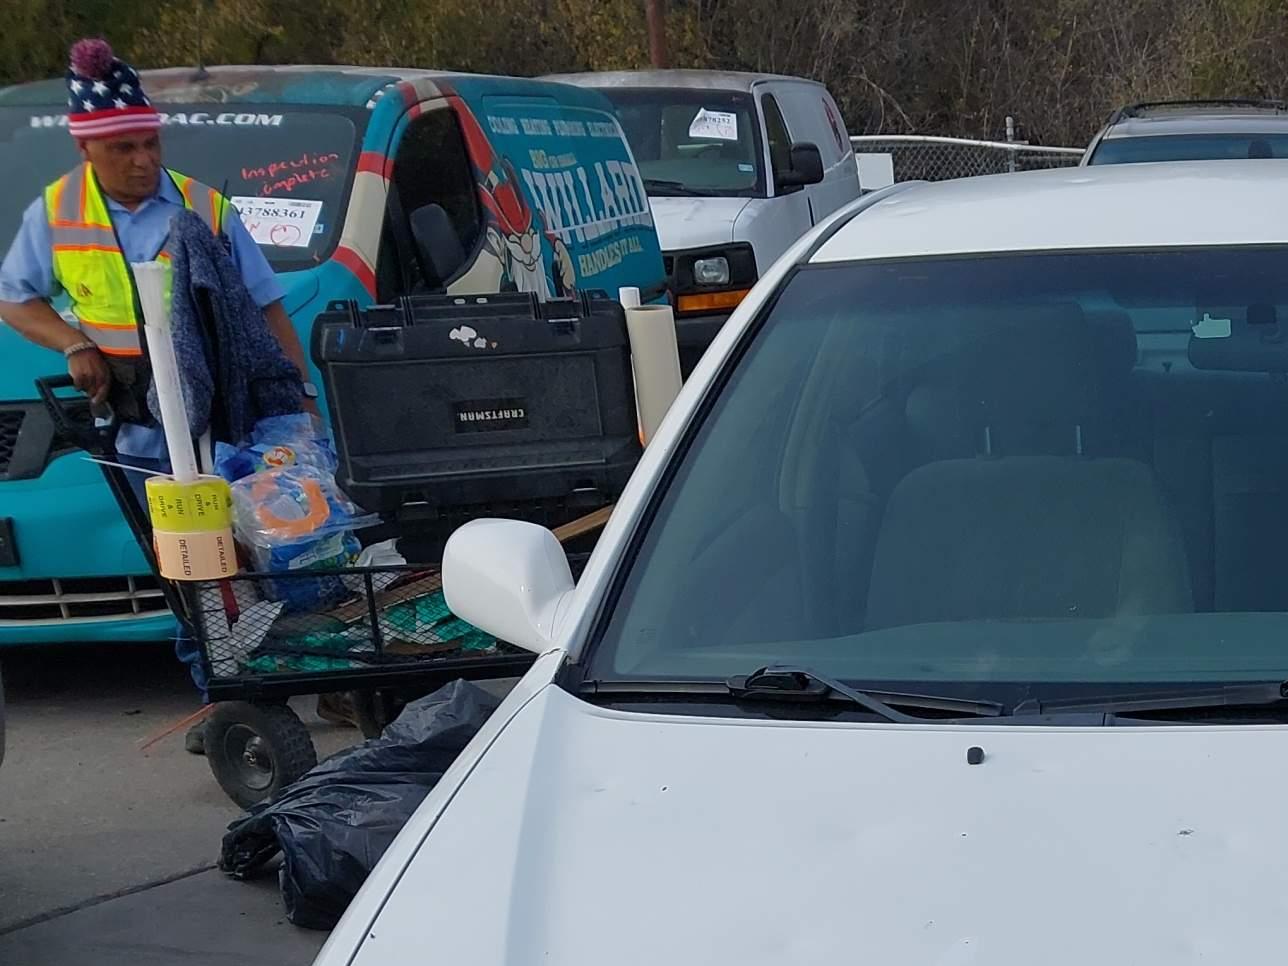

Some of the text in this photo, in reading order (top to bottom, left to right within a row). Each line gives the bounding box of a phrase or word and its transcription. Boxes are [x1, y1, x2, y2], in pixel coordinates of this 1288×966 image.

[521, 160, 653, 244] WILLARD
[578, 241, 622, 277] HANDLES
[460, 409, 524, 421] CRAFTSMAN
[194, 494, 205, 516] DRIVE
[179, 539, 191, 576] DETAILED
[216, 536, 227, 573] DETAILED
